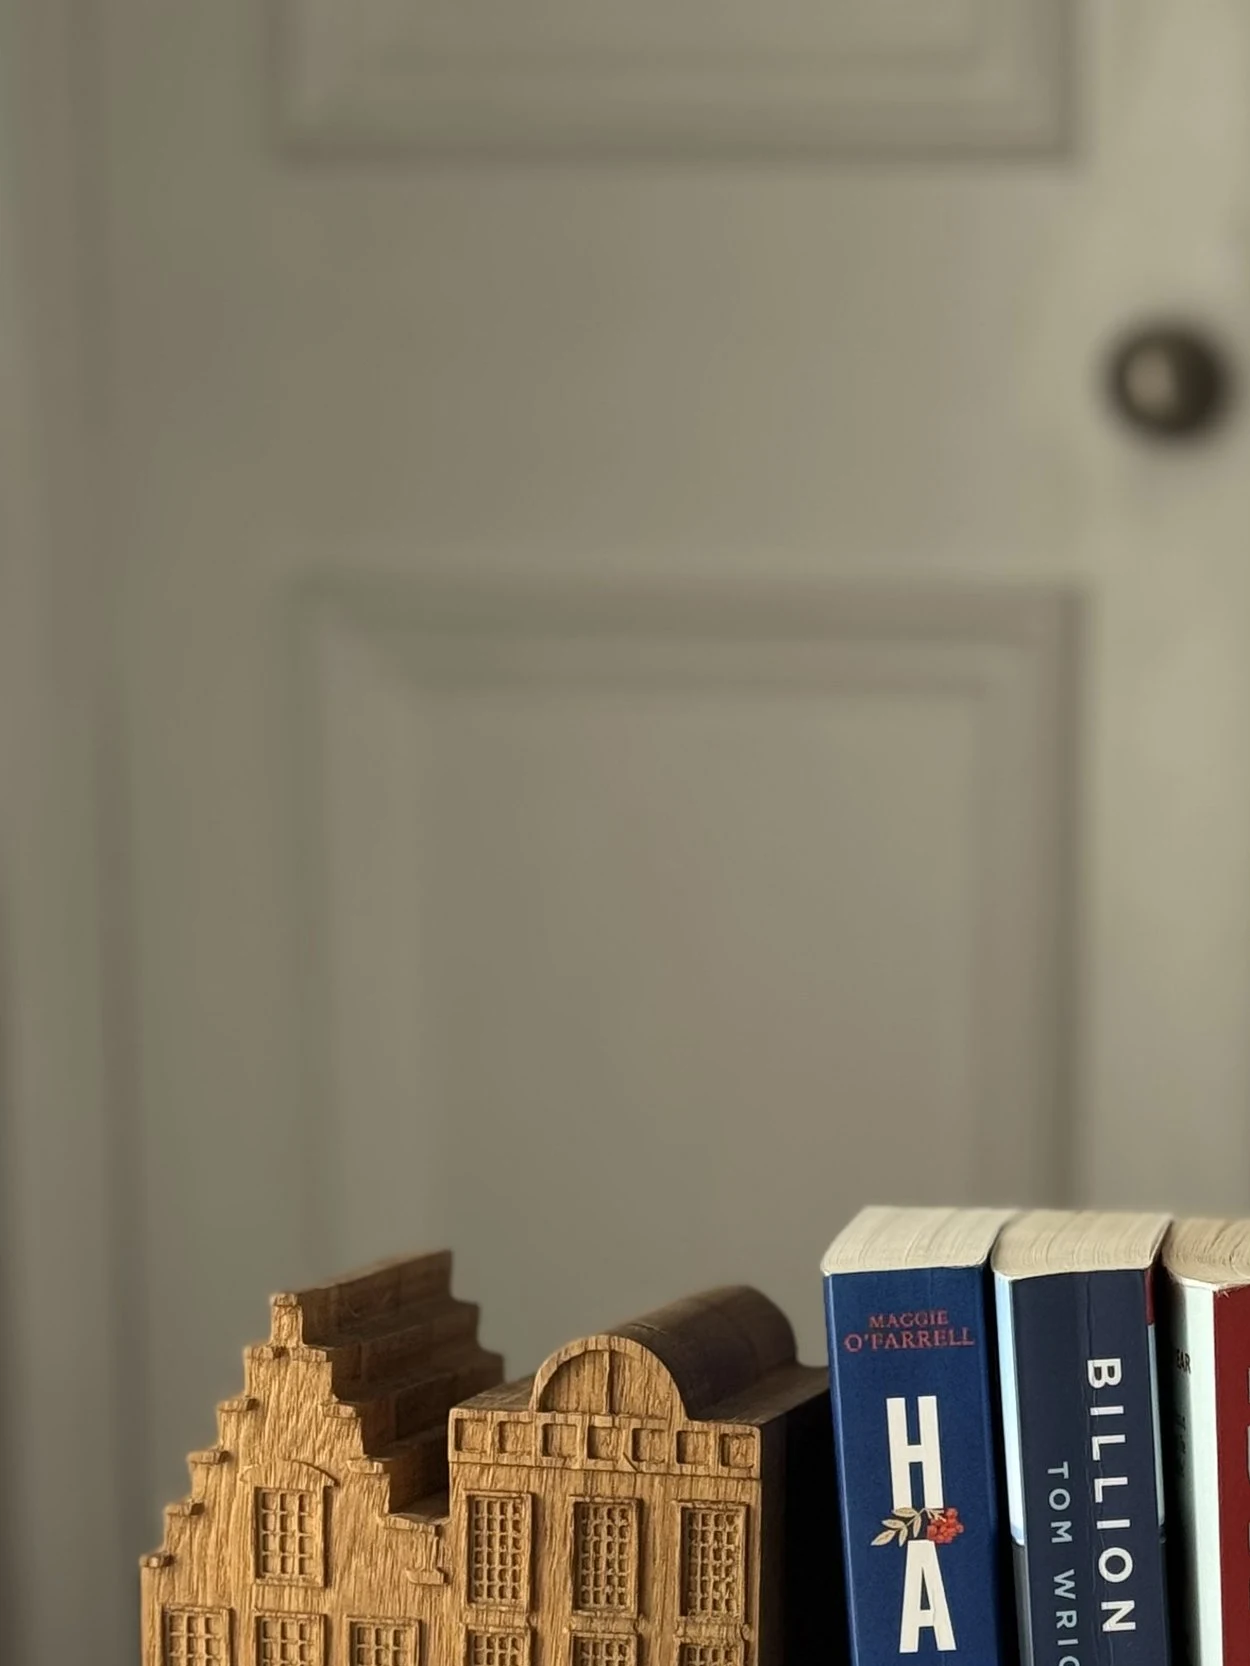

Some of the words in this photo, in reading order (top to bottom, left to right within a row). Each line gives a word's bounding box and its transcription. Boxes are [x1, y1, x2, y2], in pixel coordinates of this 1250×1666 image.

[844, 1327, 975, 1353] O'FARRELL
[869, 1310, 949, 1328] MAGGIE
[1047, 1461, 1073, 1544] TOM
[1087, 1358, 1137, 1632] BILLION
